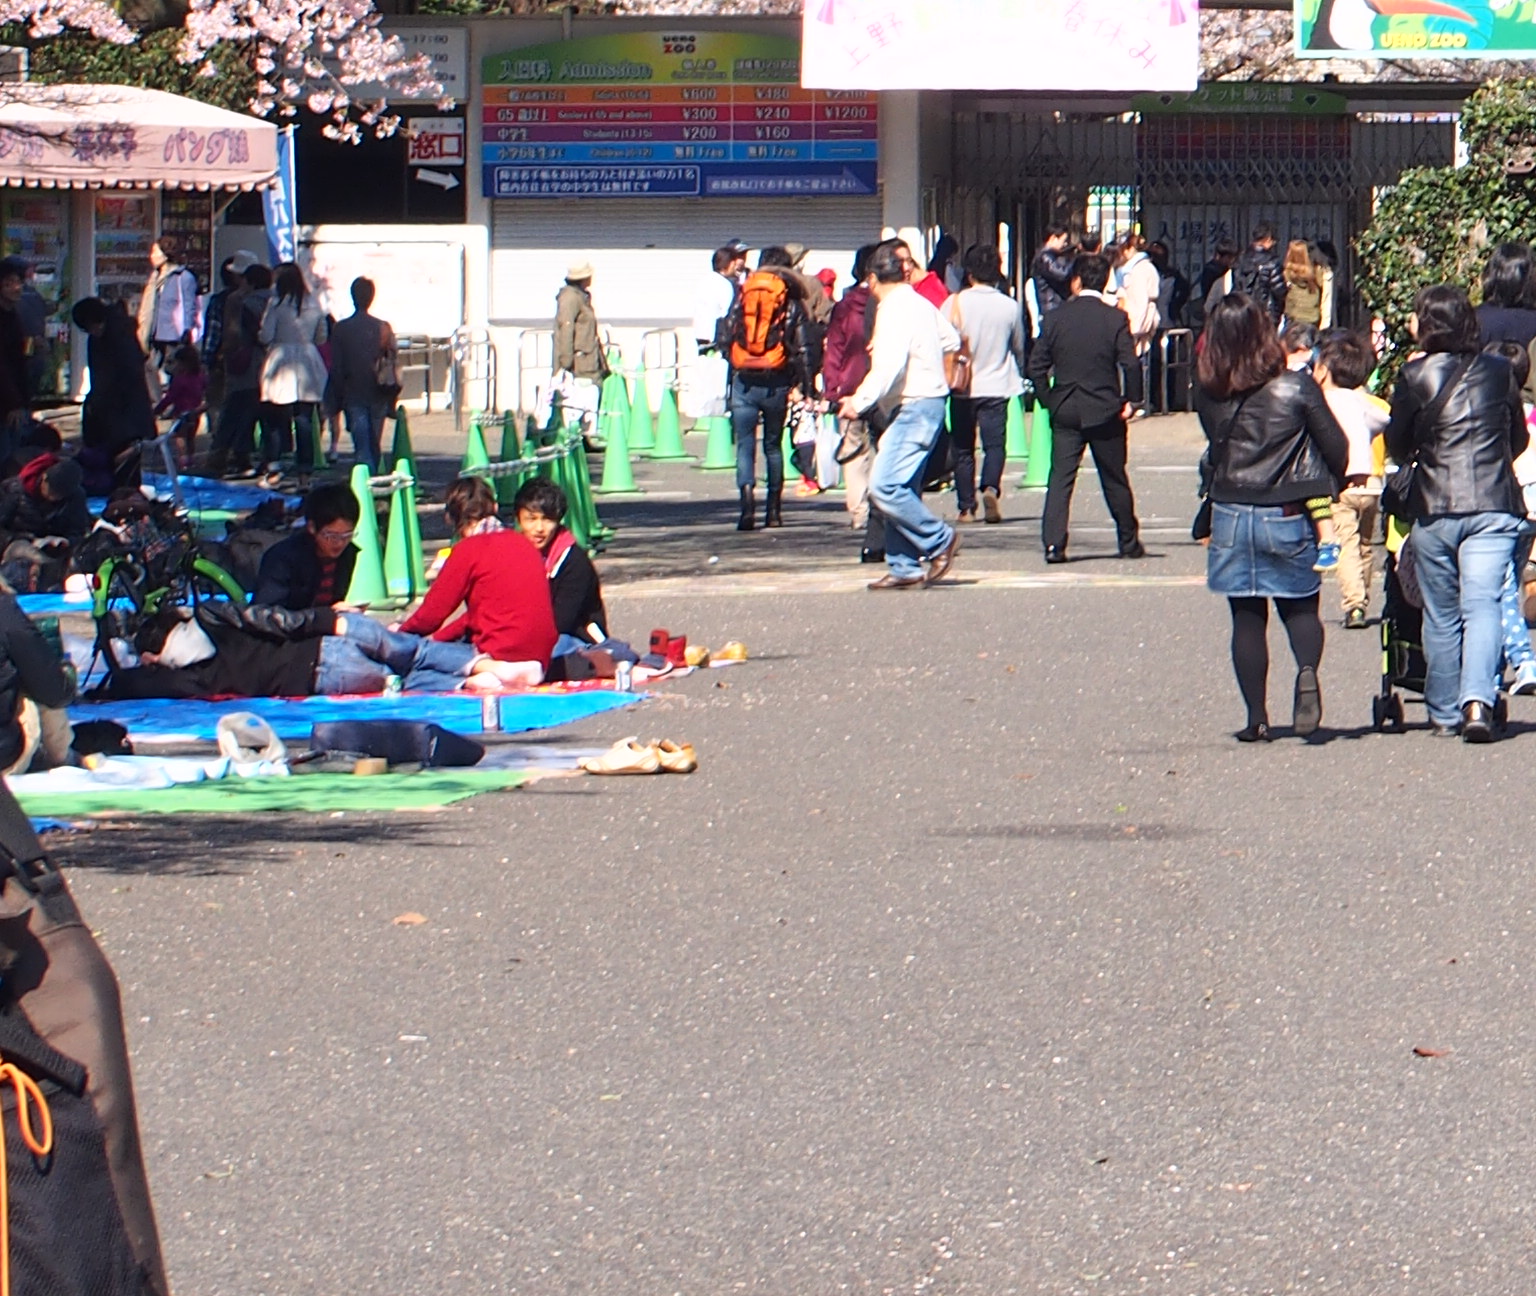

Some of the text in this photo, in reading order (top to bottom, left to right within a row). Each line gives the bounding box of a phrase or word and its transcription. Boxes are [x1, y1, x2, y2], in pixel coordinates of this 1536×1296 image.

[1380, 32, 1467, 49] UENO ZOO
[559, 59, 653, 80] Admission
[682, 108, 717, 121] ¥300
[756, 107, 790, 120] ¥240
[825, 107, 868, 119] ¥1200
[682, 127, 717, 140] ¥200
[756, 126, 790, 139] ¥160
[410, 132, 463, 160] 窓口
